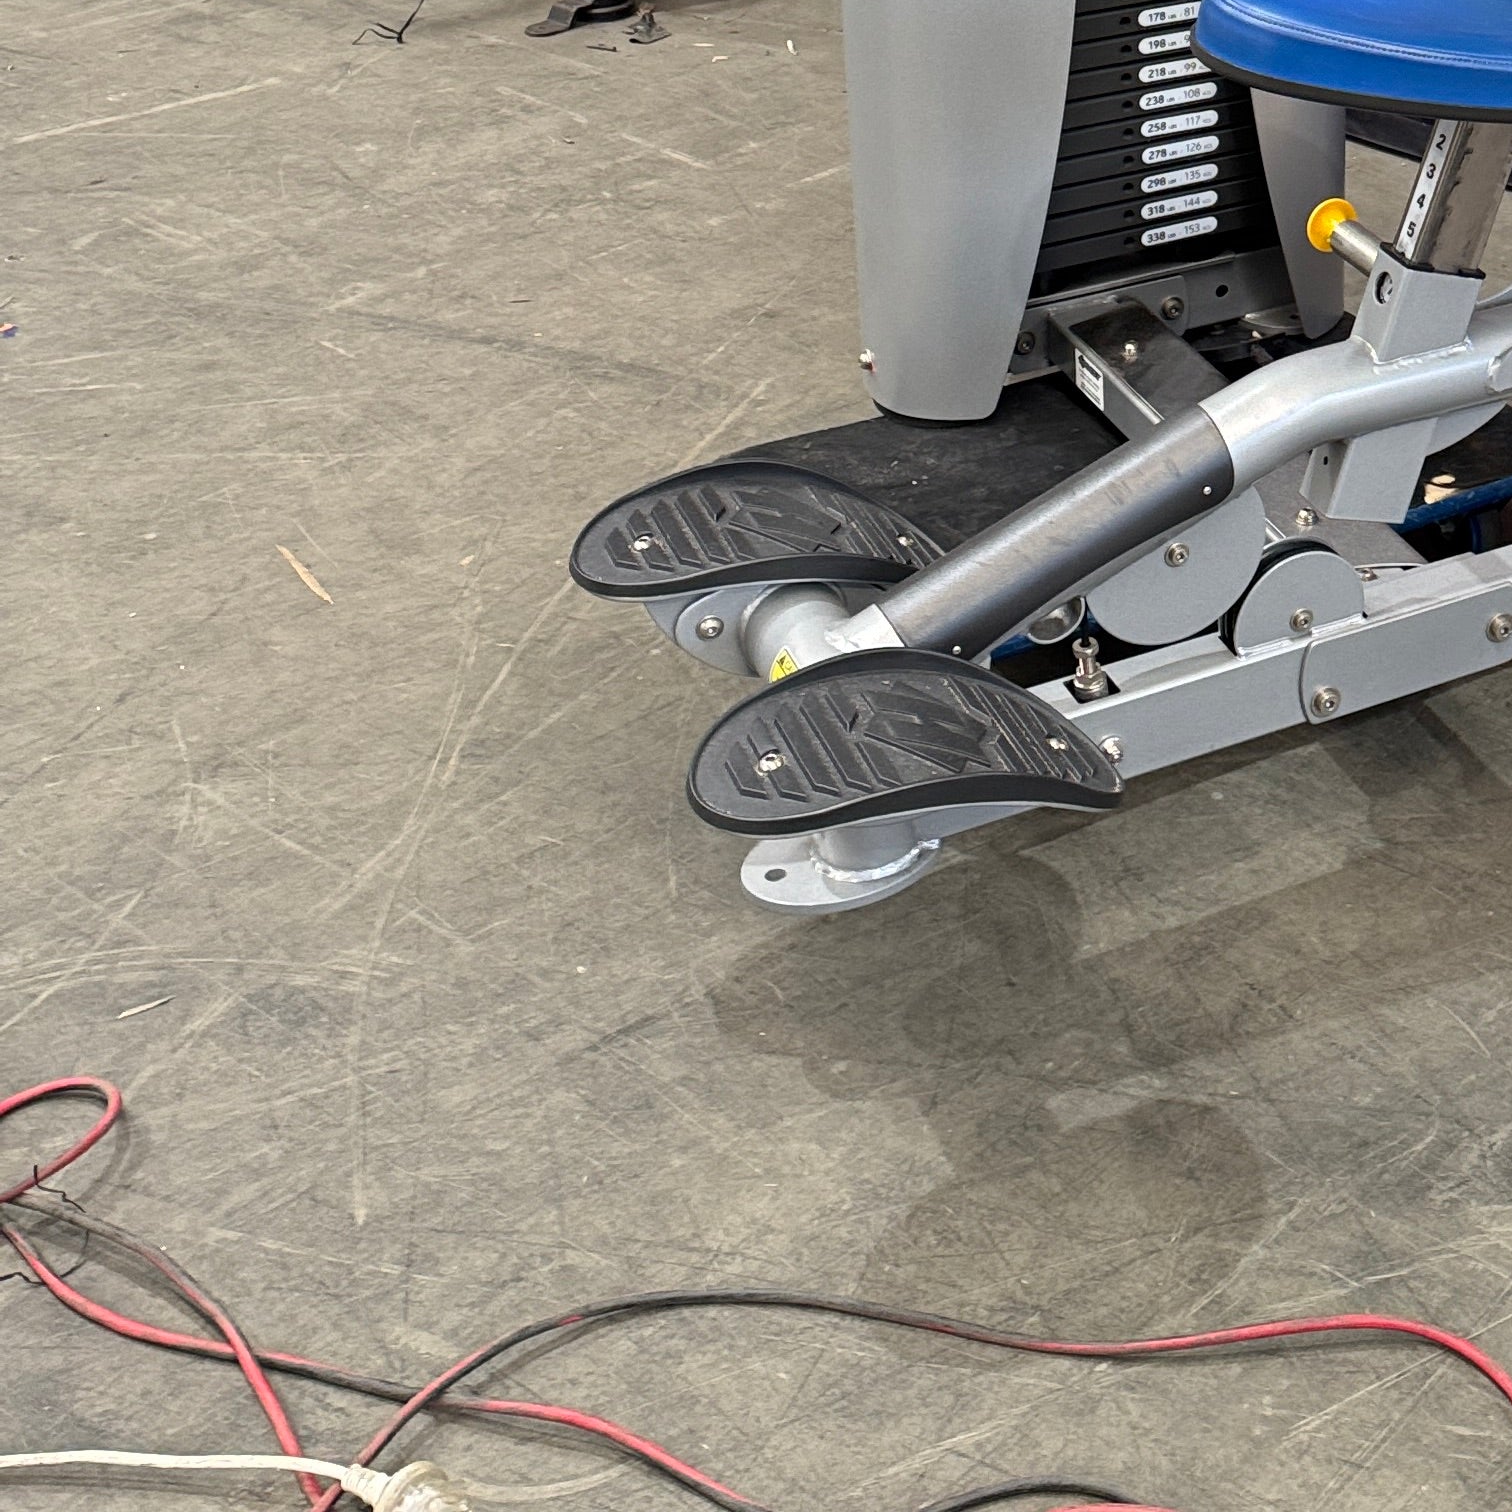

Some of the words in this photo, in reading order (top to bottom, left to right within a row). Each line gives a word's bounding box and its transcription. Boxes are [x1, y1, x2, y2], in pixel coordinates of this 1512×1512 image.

[1147, 11, 1167, 22] 178
[1183, 6, 1196, 17] 81
[1147, 38, 1167, 50] 198
[1147, 67, 1167, 79] 218
[1183, 61, 1198, 73] 99
[1145, 94, 1165, 107] 238
[1182, 88, 1202, 99] 108
[1147, 121, 1167, 132] 258
[1184, 115, 1202, 126] 117
[1436, 134, 1446, 150] 2
[1147, 148, 1168, 160] 278
[1184, 142, 1202, 153] 126
[1146, 177, 1167, 189] 298
[1183, 169, 1202, 181] 135
[1426, 163, 1436, 179] 3
[1146, 204, 1166, 216] 318
[1182, 196, 1202, 209] 144
[1417, 193, 1426, 209] 4
[1146, 231, 1167, 243] 338
[1183, 223, 1202, 235] 153
[1406, 221, 1416, 237] 5
